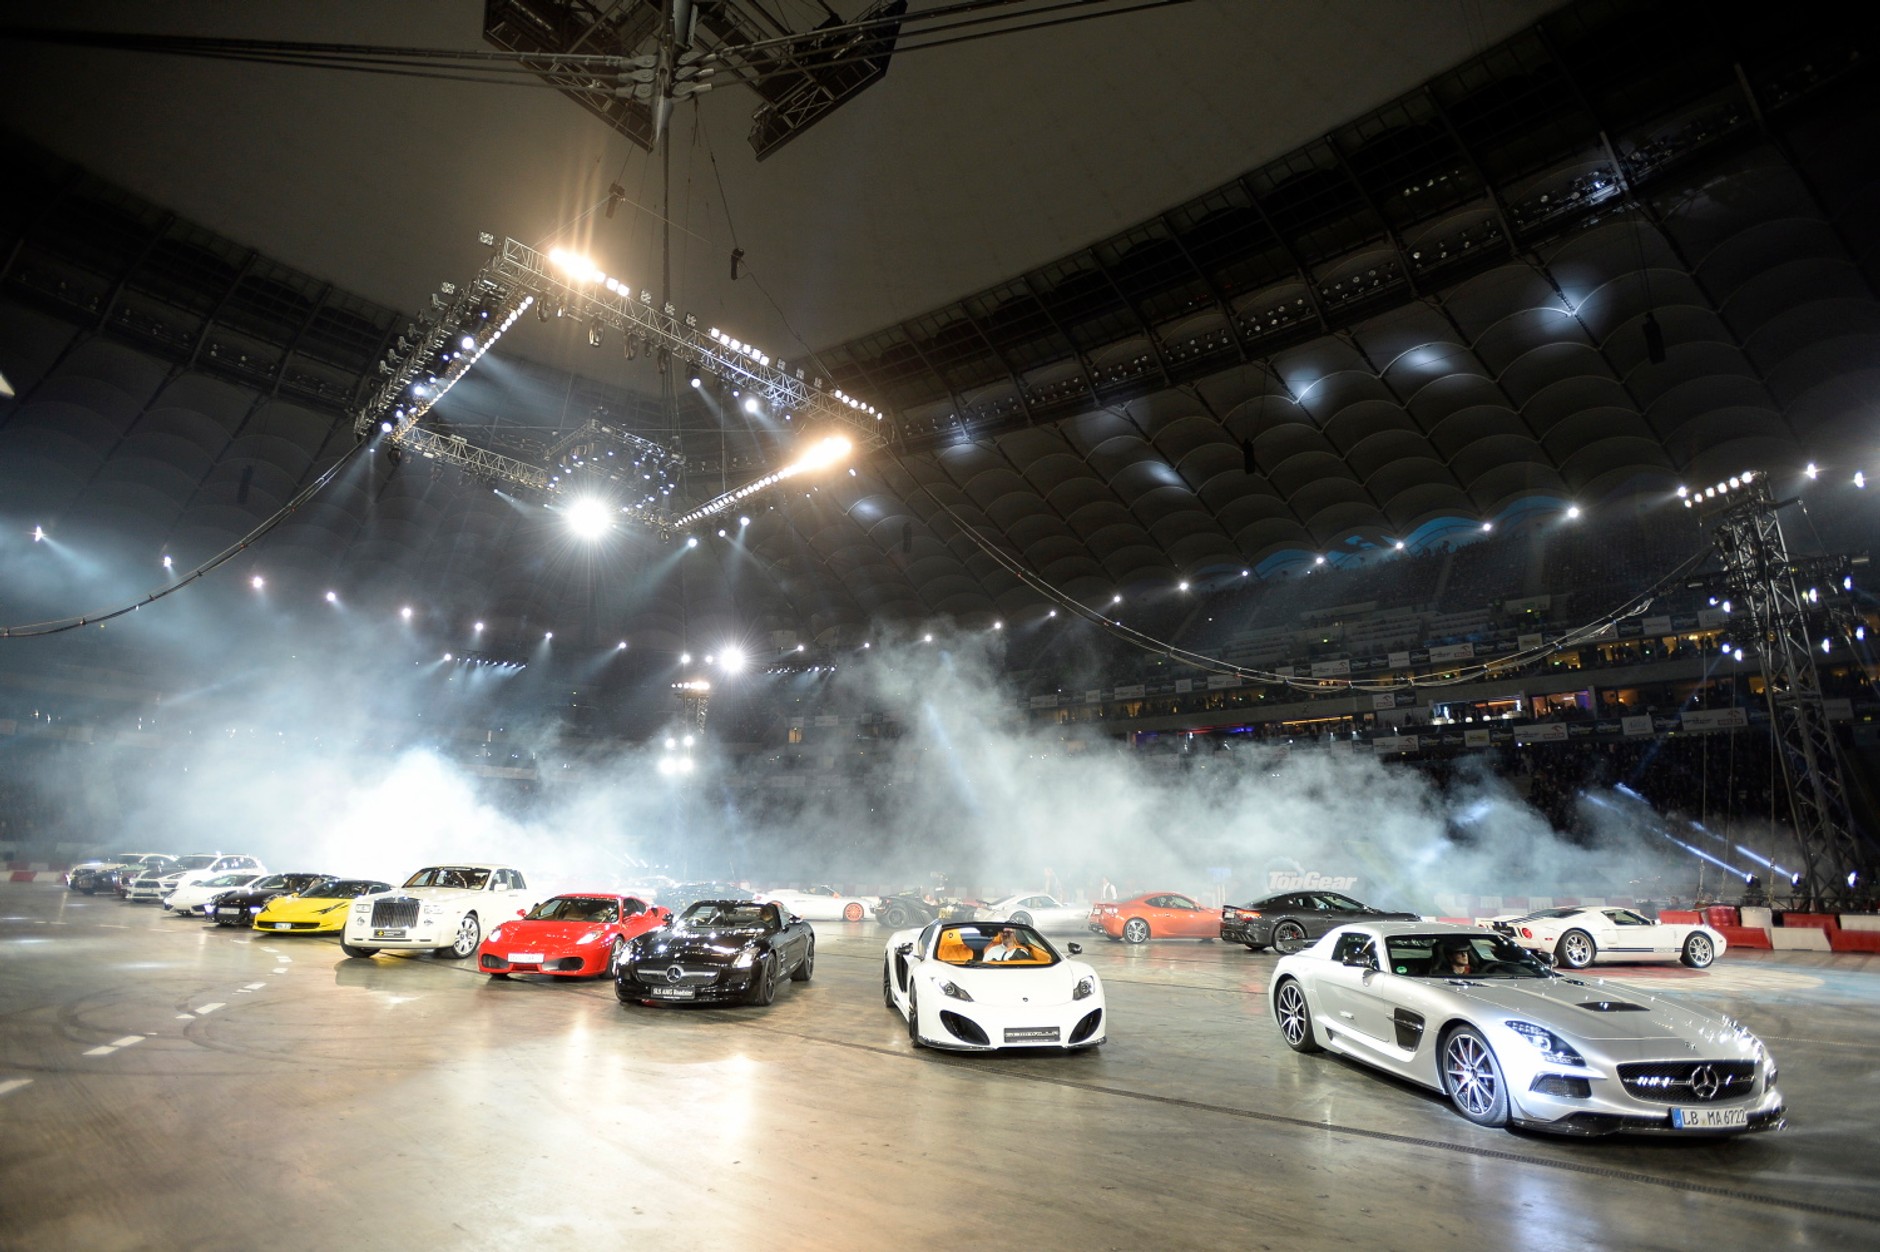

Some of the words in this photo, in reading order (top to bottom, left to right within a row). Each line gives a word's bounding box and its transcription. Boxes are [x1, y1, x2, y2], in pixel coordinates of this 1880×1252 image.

[1682, 1110, 1699, 1125] LB
[1707, 1111, 1722, 1125] MA
[1724, 1109, 1746, 1124] 6722
